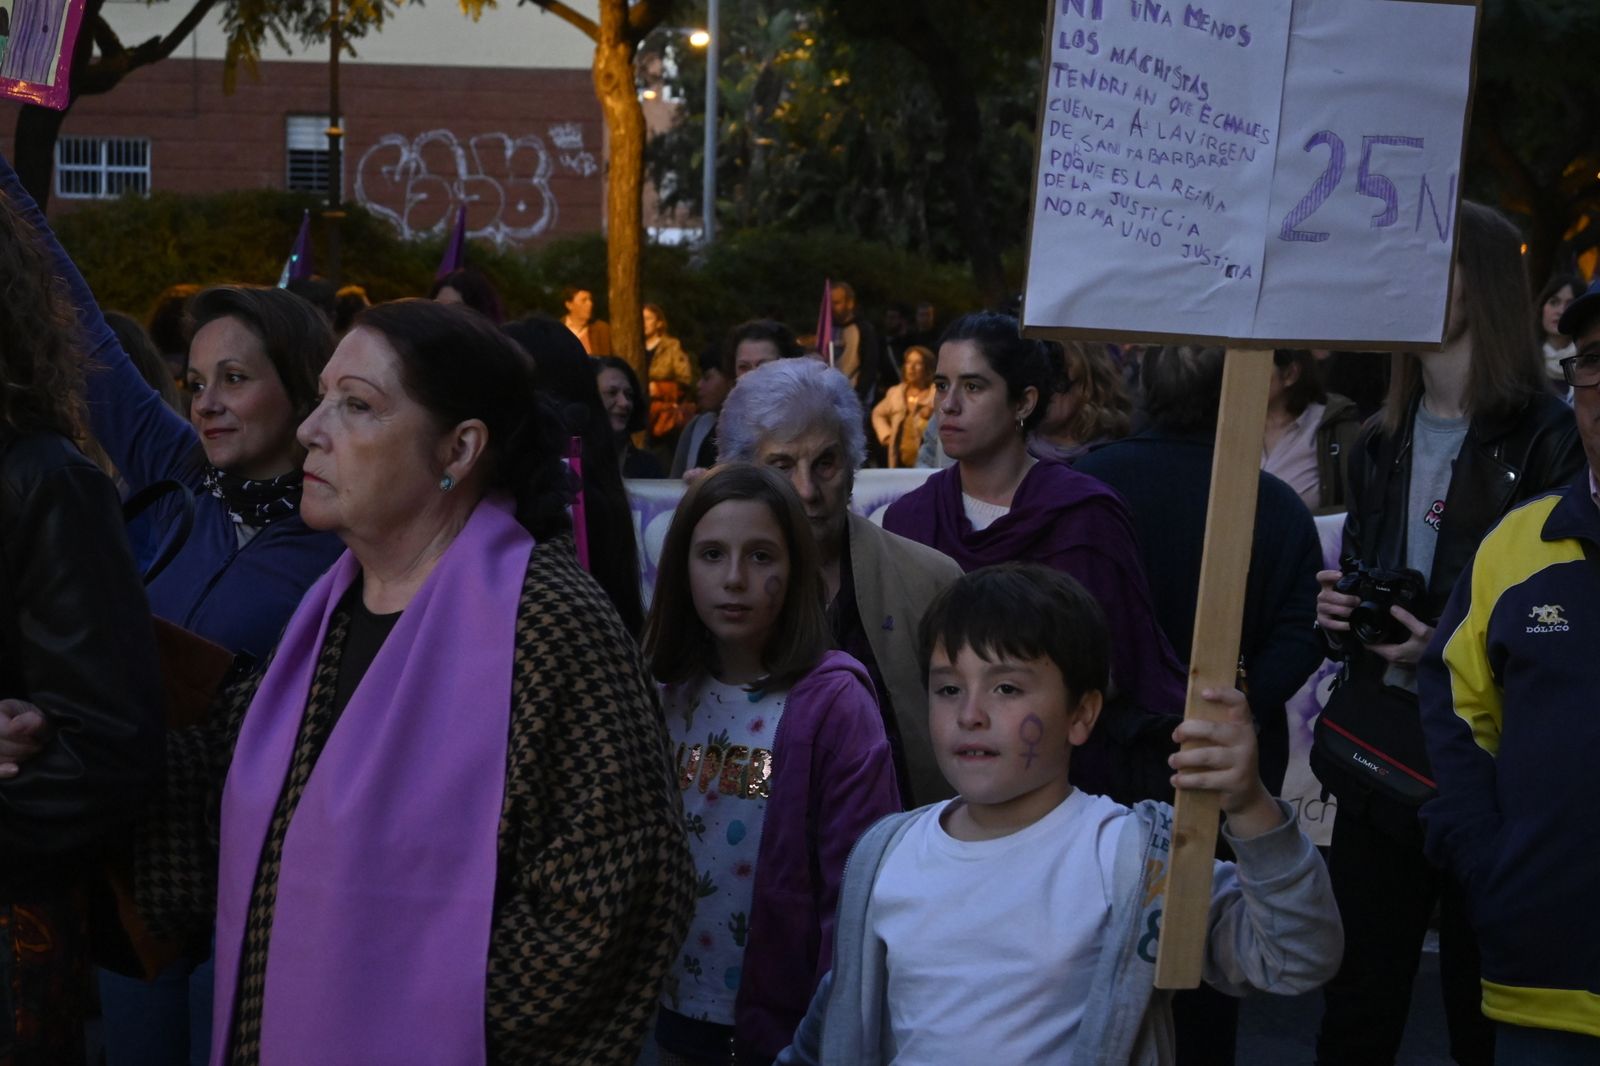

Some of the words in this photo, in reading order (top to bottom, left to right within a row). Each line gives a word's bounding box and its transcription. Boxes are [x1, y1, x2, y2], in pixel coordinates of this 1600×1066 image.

[1062, 0, 1102, 20] NI
[1184, 3, 1252, 47] MENOS
[1059, 29, 1099, 55] LOS
[1110, 46, 1209, 100] MACHISTAS
[1049, 98, 1115, 131] CUENTA
[1050, 119, 1073, 140] DE
[1171, 177, 1227, 213] REINA
[1109, 191, 1200, 238] JUSTICIA
[675, 742, 773, 800] UPER
[1352, 752, 1380, 773] LUMIX
